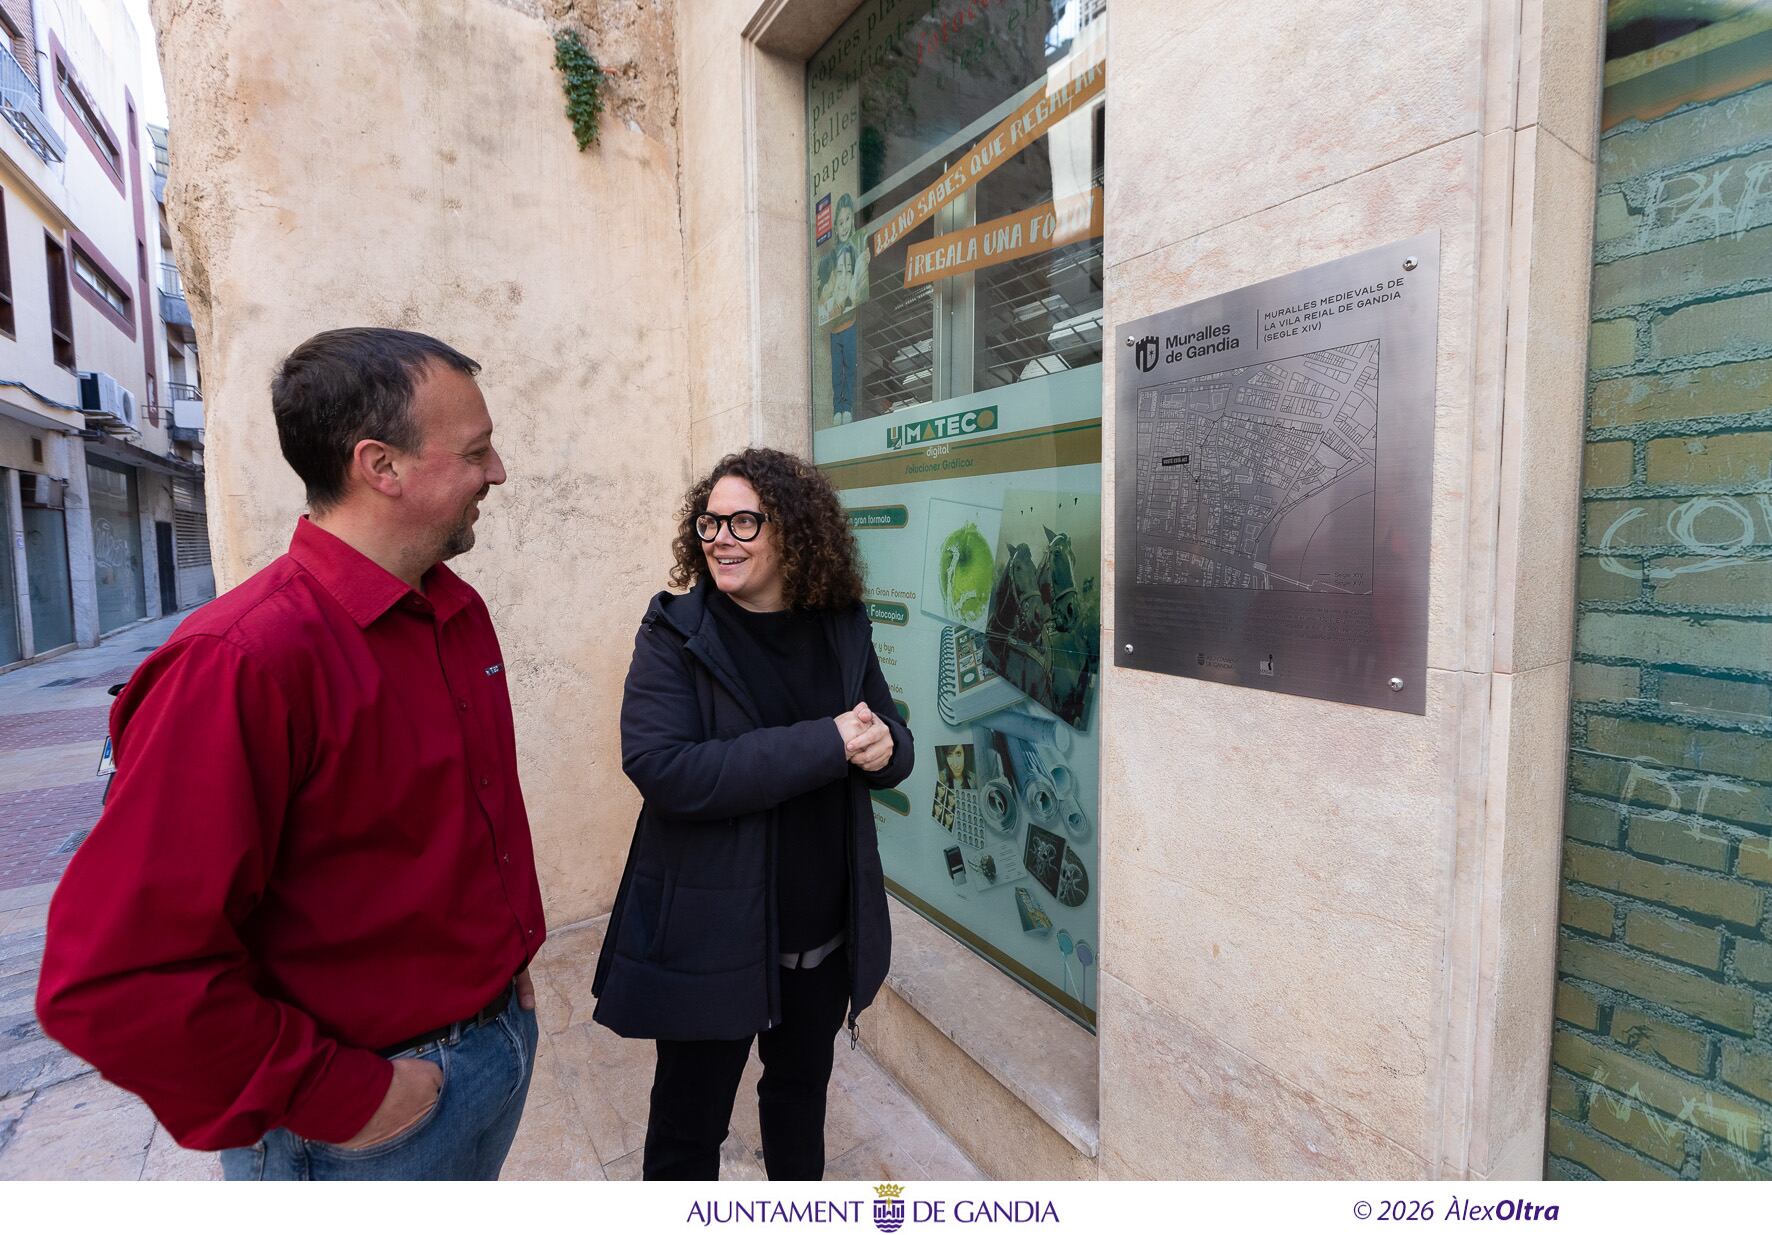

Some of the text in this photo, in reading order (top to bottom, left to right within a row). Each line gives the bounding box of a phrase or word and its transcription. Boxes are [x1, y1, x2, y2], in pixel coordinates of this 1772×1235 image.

[918, 166, 968, 217] SABES
[970, 132, 1006, 176] QUE
[983, 223, 1023, 257] UNA
[1264, 277, 1405, 320] MURALLES MEDIEVALS DE
[1264, 291, 1402, 332] LA VILA REIAL DE GANDIA
[1165, 322, 1231, 349] Muralles
[1264, 321, 1322, 342] (SEGLE XIV)
[1165, 337, 1240, 364] de Gandia
[906, 409, 996, 443] MATECO
[926, 443, 950, 459] digital
[891, 589, 916, 600] Formato
